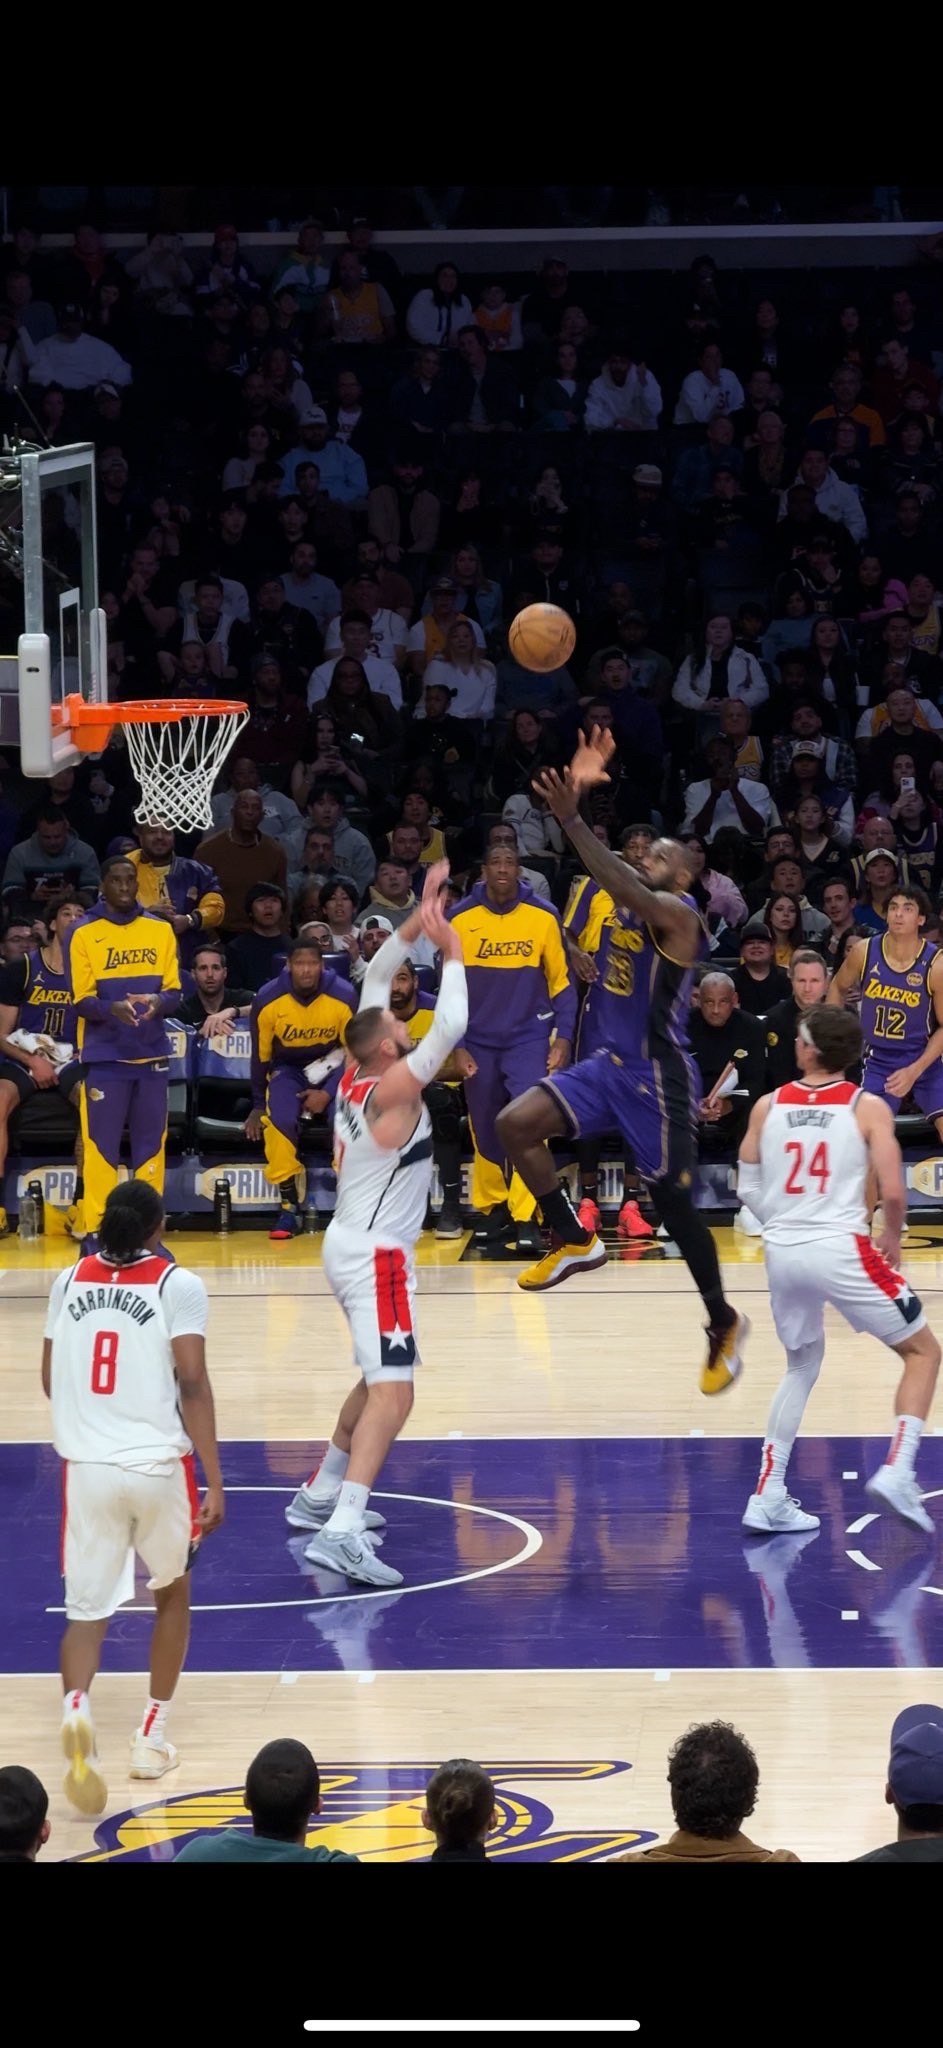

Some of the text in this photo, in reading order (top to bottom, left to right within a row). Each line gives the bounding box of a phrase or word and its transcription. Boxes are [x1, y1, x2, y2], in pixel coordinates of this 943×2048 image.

[104, 947, 158, 971] LAKERS
[475, 938, 534, 960] LAKERS
[27, 986, 72, 1006] LAKER
[864, 978, 921, 1008] LAKERS
[42, 1007, 65, 1038] 11
[282, 1023, 337, 1042] LAKERS
[873, 1005, 906, 1039] 12
[226, 1035, 251, 1055] PRI
[784, 1141, 832, 1195] 24
[223, 1170, 283, 1198] PRIM
[67, 1287, 156, 1327] CARRINGTON
[91, 1330, 119, 1395] 8
